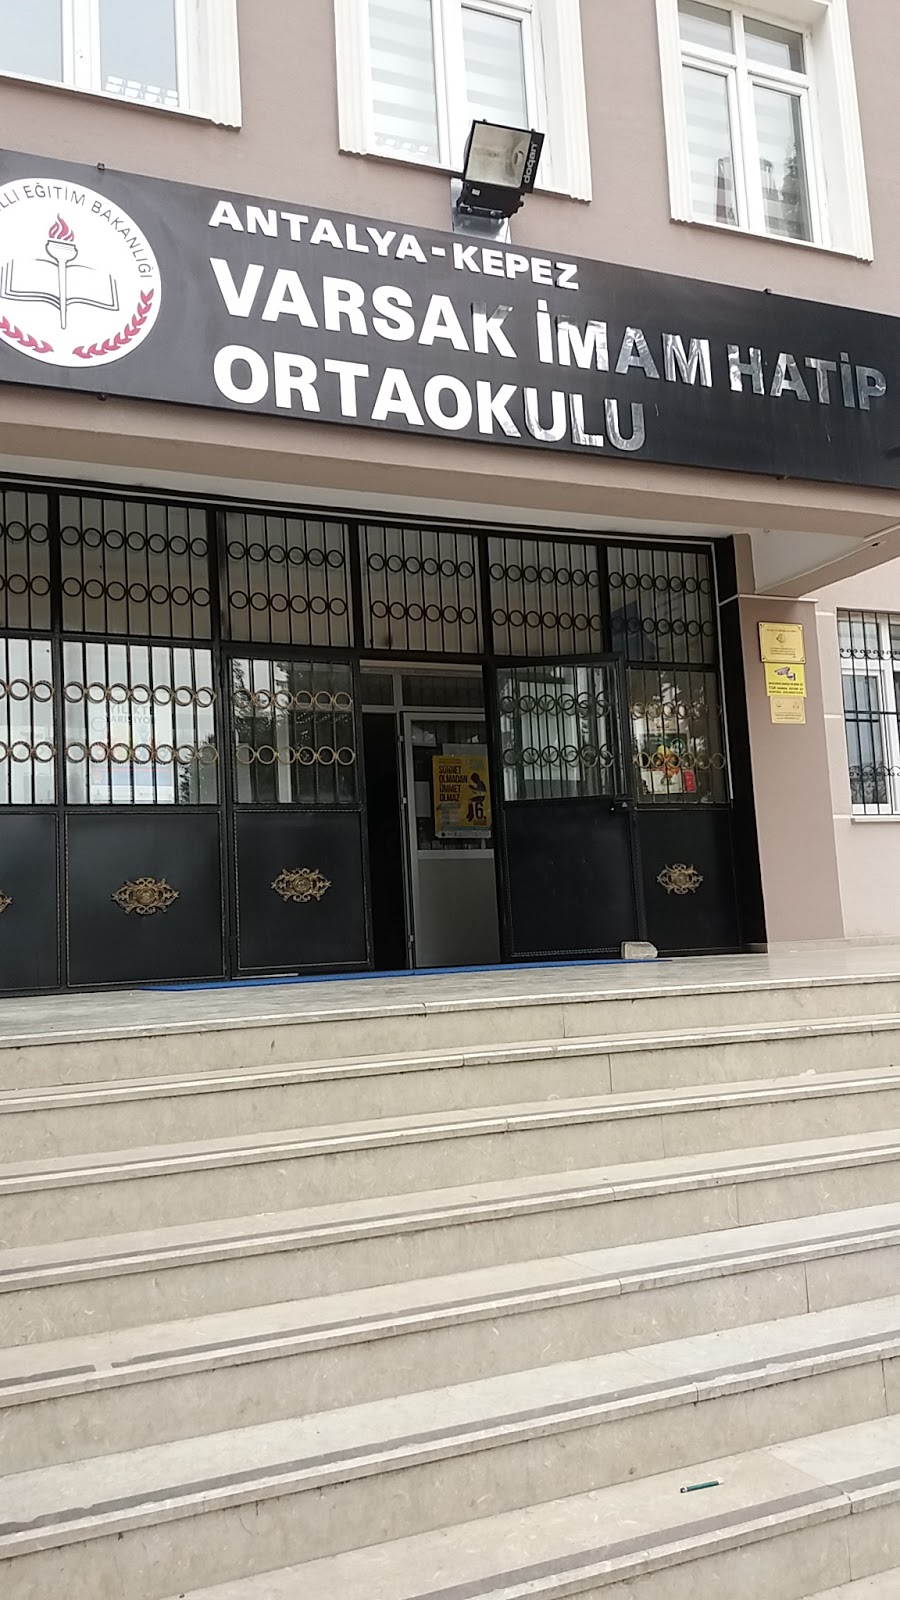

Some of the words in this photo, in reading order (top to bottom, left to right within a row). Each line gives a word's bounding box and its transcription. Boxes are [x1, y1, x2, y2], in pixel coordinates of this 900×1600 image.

[91, 200, 153, 278] BAKANLIĞI
[209, 257, 517, 358] VARSAK
[537, 299, 712, 388] İMAM
[727, 344, 887, 411] HATİP
[213, 344, 646, 451] ORTAOKULU
